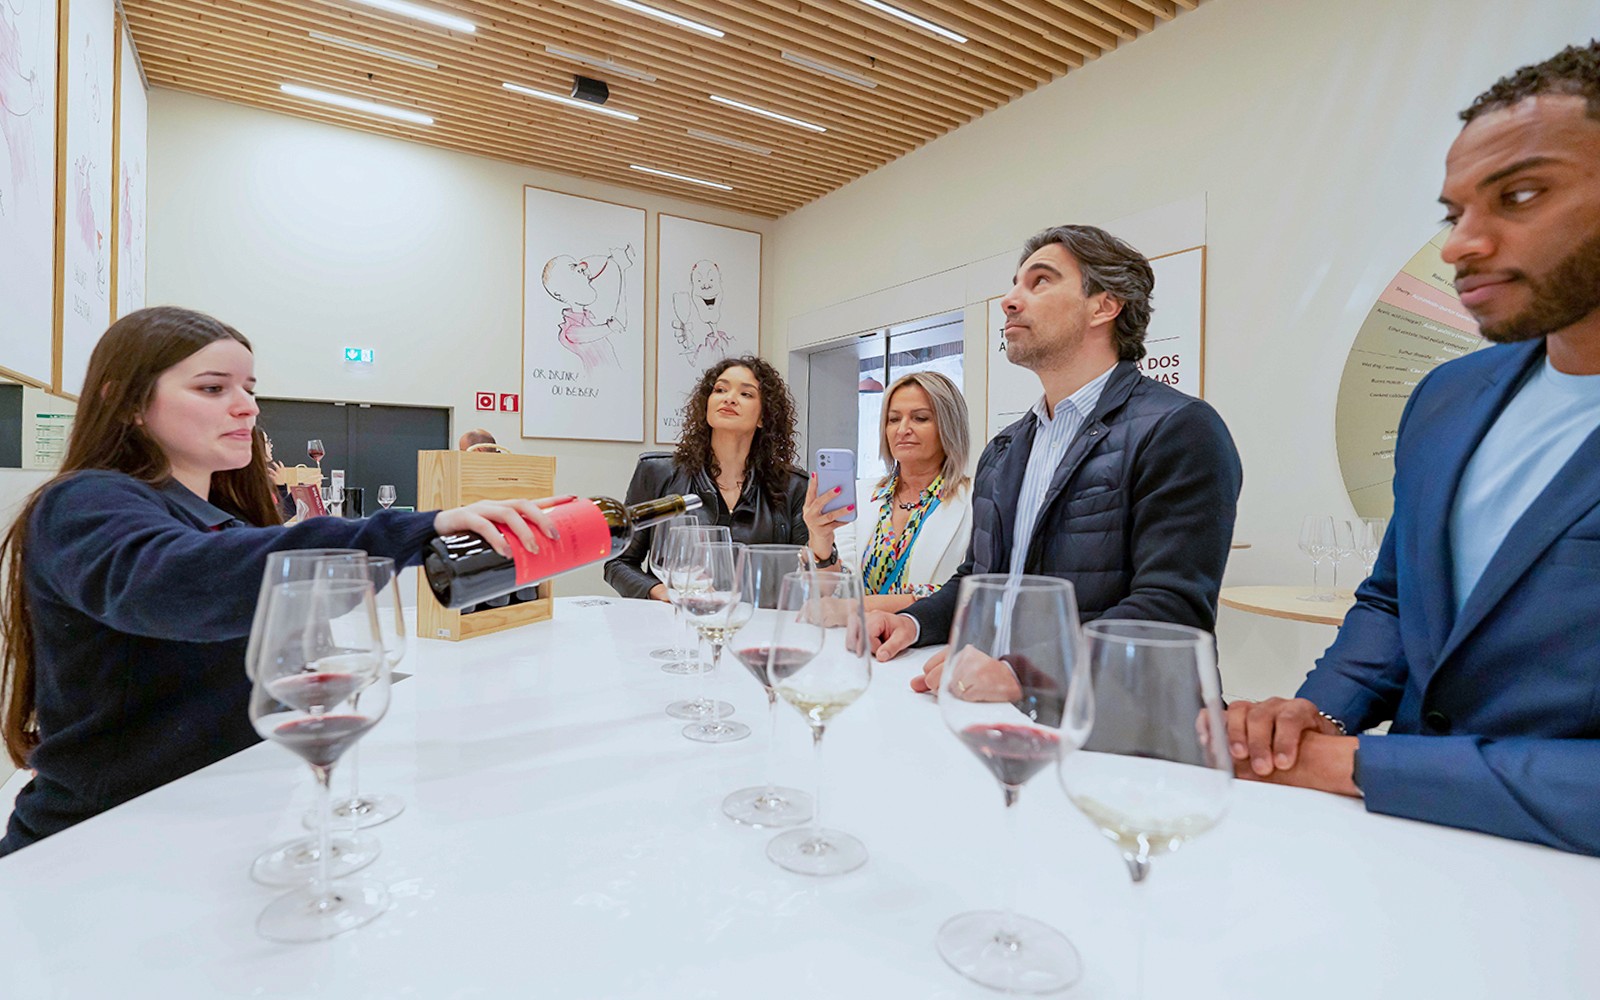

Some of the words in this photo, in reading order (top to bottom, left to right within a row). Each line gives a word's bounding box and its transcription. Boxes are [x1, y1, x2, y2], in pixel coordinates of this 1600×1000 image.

[1148, 354, 1180, 370] DOS
[533, 367, 546, 380] OR
[548, 369, 579, 382] DRINK!
[565, 386, 599, 398] BEBER!
